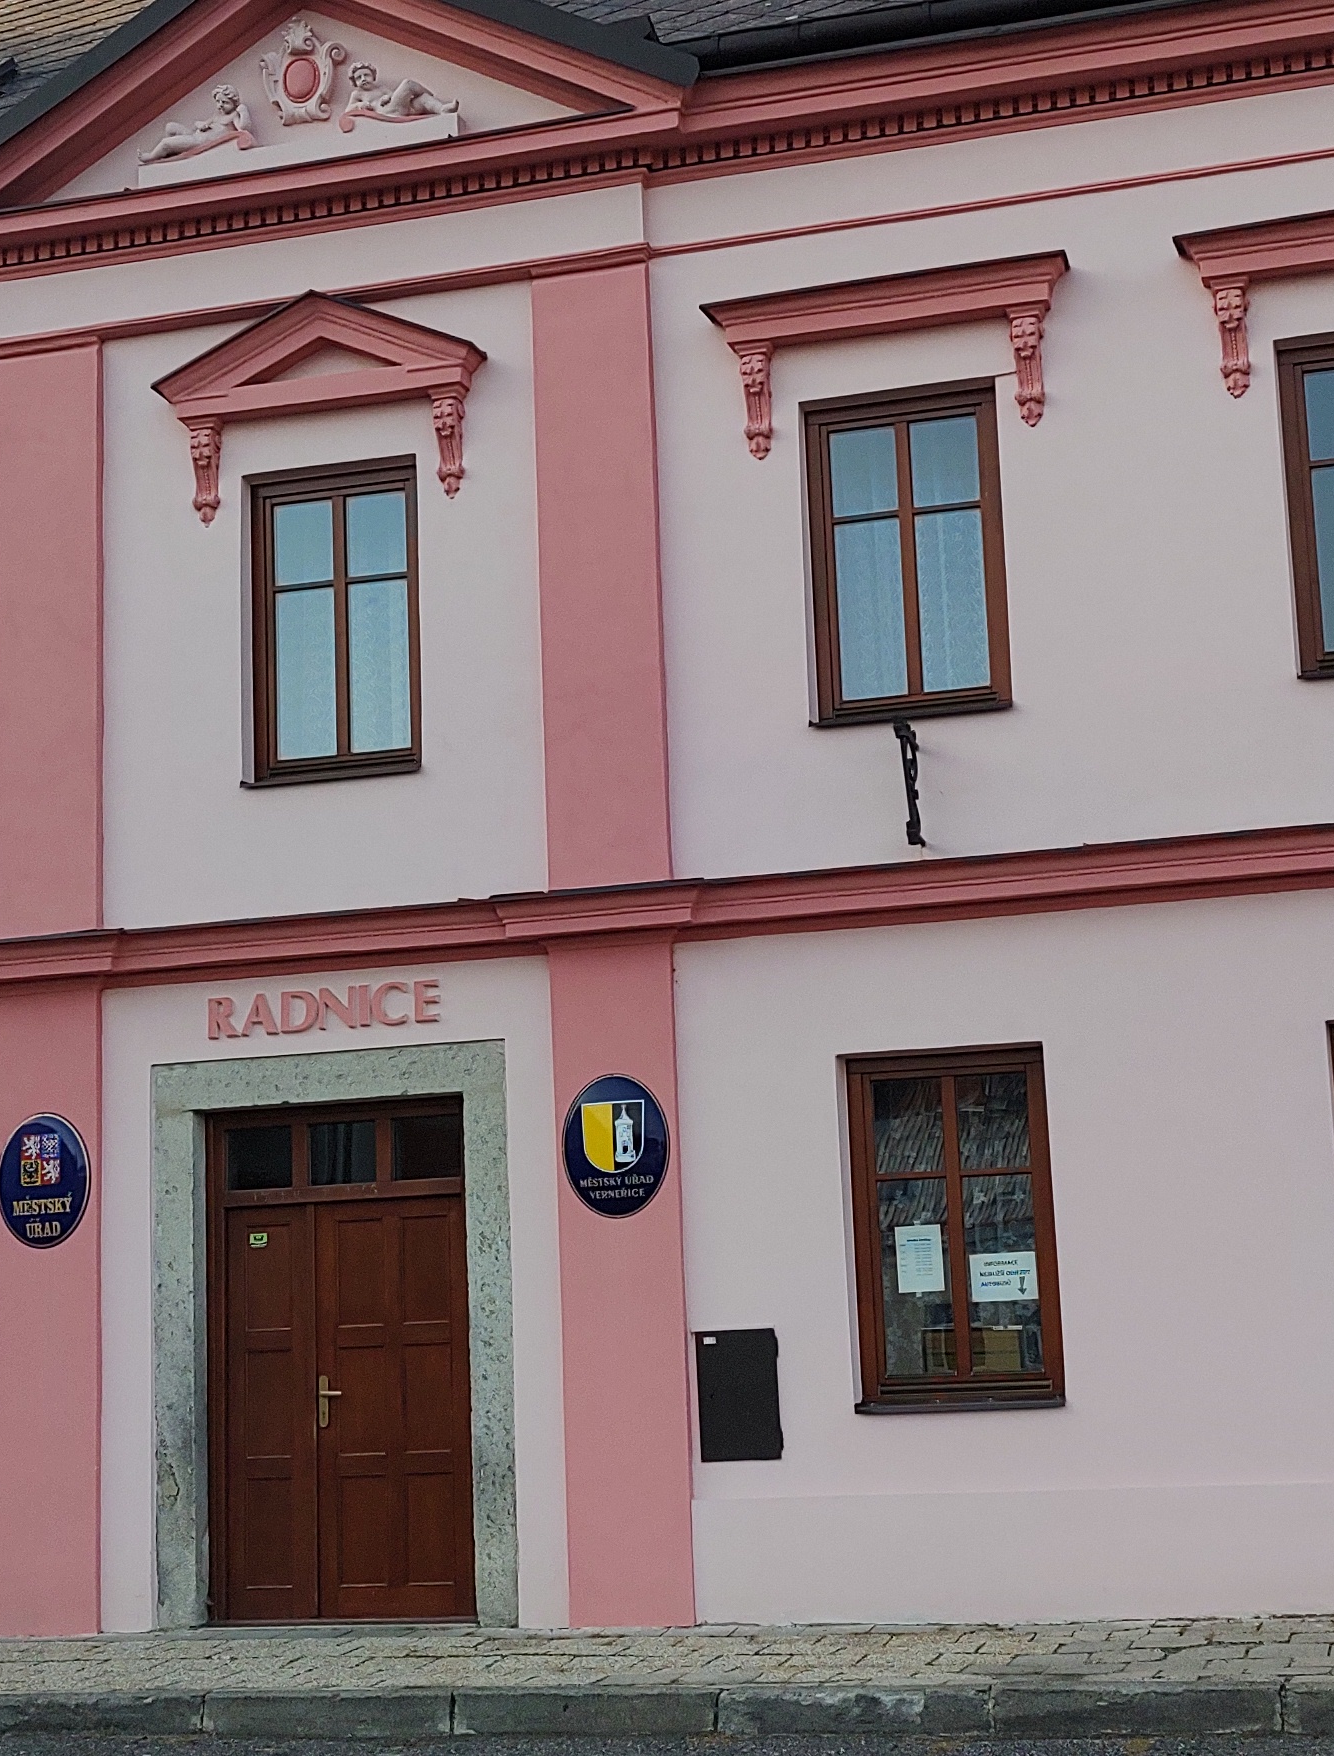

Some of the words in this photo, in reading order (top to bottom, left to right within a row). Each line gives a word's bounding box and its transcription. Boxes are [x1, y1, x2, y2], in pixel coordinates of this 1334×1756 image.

[207, 978, 441, 1041] RADNICE
[579, 1175, 623, 1188] MĚSTSKÝ
[624, 1173, 655, 1185] ÚŘAD
[12, 1192, 73, 1217] MĚSTSKÝ
[25, 1217, 62, 1239] ÚŘAD
